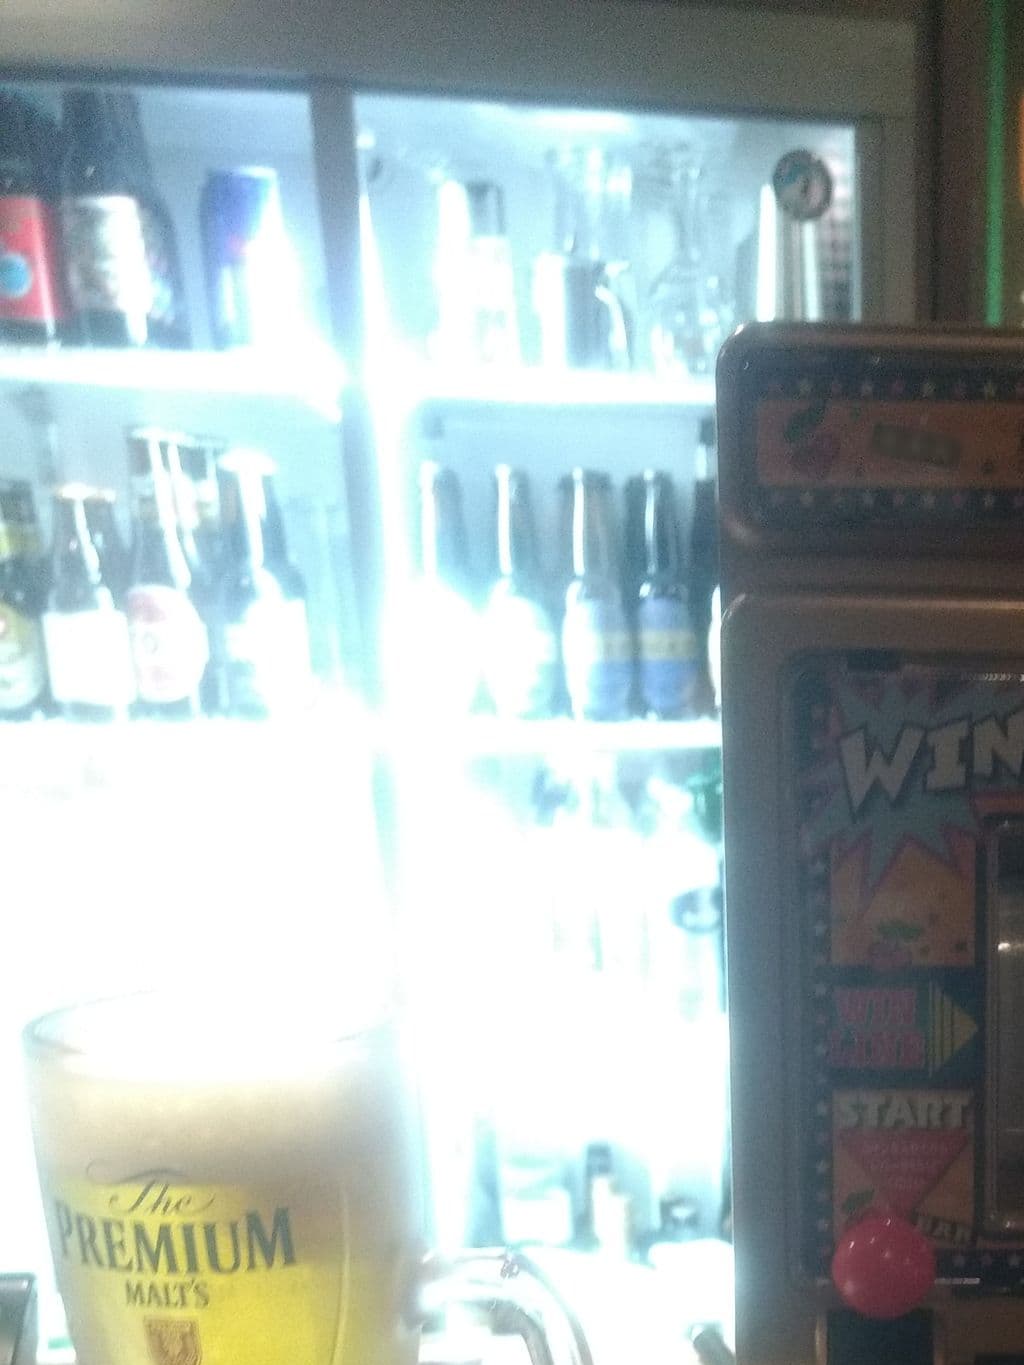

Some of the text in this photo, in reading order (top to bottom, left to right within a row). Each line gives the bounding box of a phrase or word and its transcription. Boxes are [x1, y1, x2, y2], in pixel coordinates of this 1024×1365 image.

[838, 1095, 970, 1129] START
[54, 1198, 297, 1275] PREMIUM
[124, 1278, 210, 1309] MALT'S
